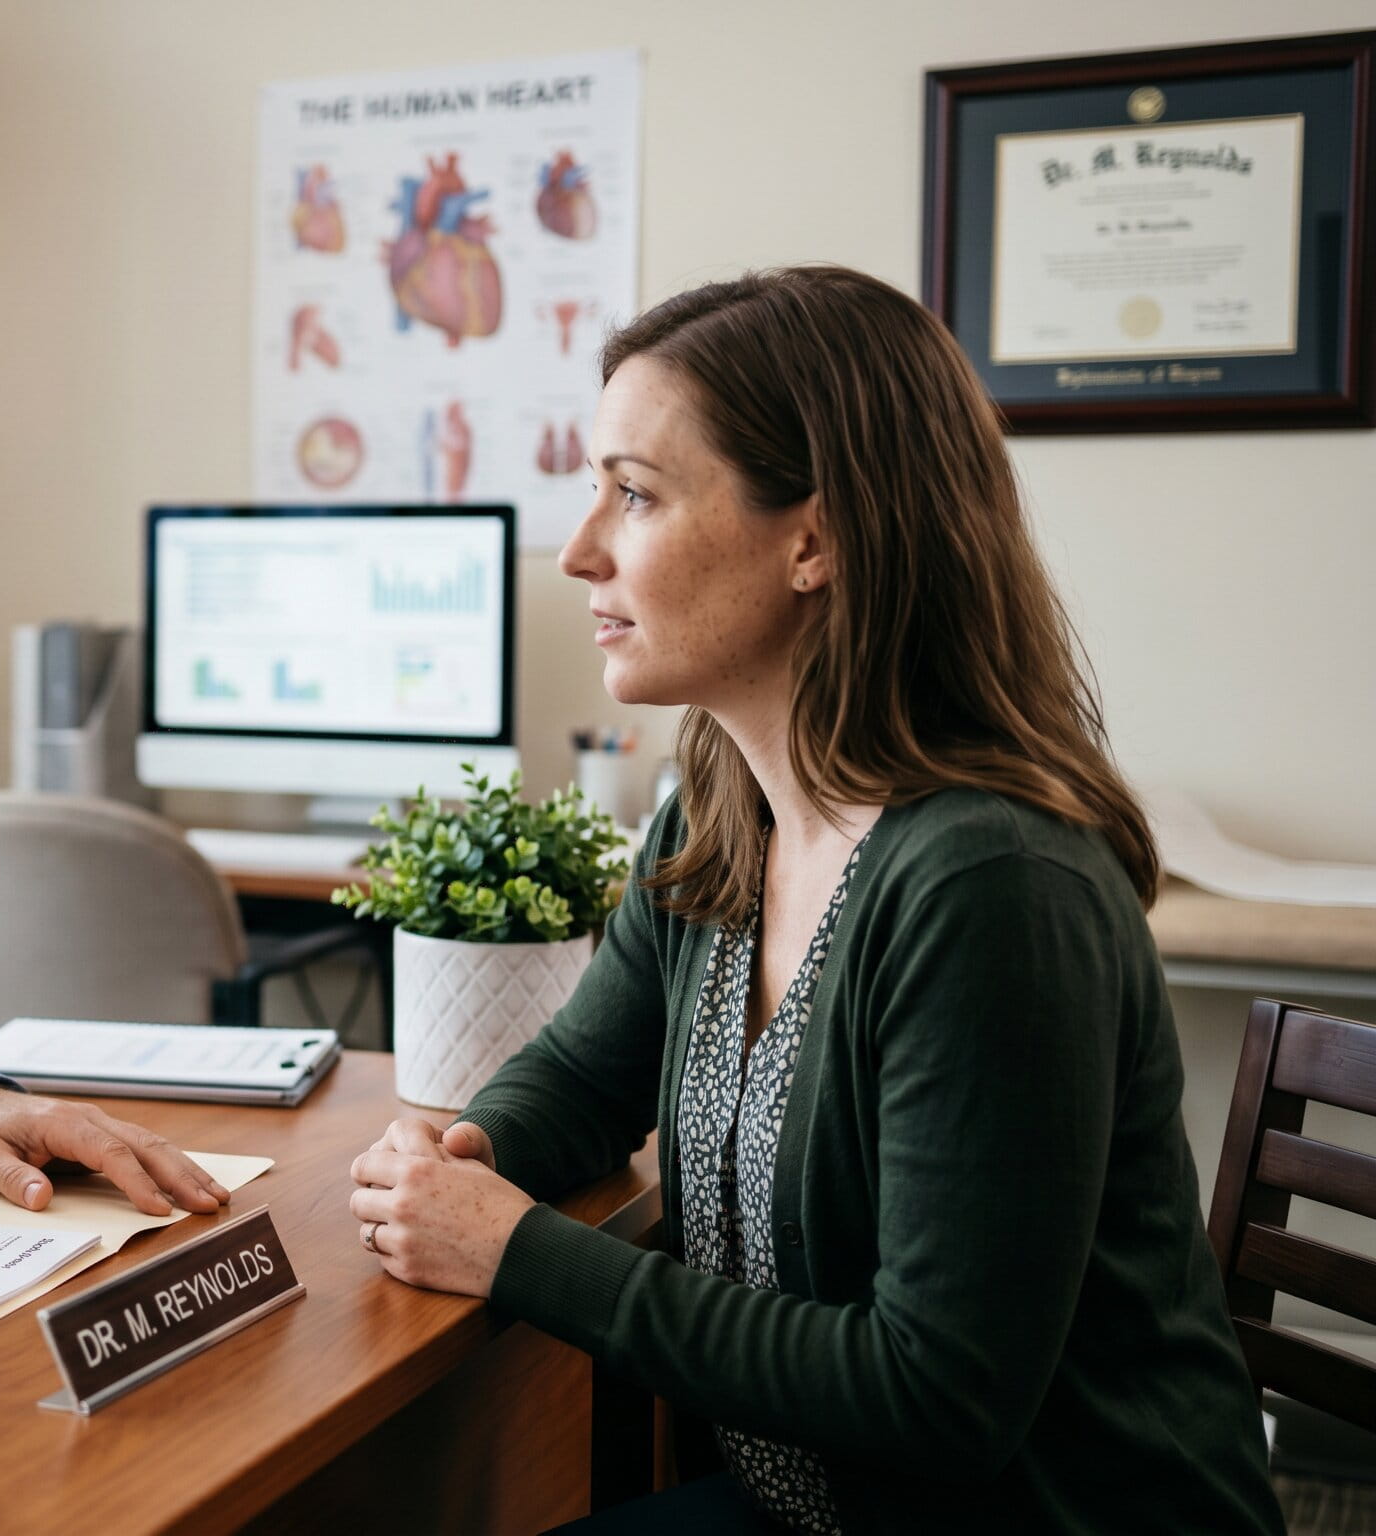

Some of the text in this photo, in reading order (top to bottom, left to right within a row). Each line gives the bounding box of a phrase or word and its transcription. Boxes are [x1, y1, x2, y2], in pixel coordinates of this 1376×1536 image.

[299, 75, 594, 125] THE HUMAN HEART
[1135, 141, 1255, 176] Reynolds
[76, 1243, 274, 1368] DR. M. REYNOLDS
